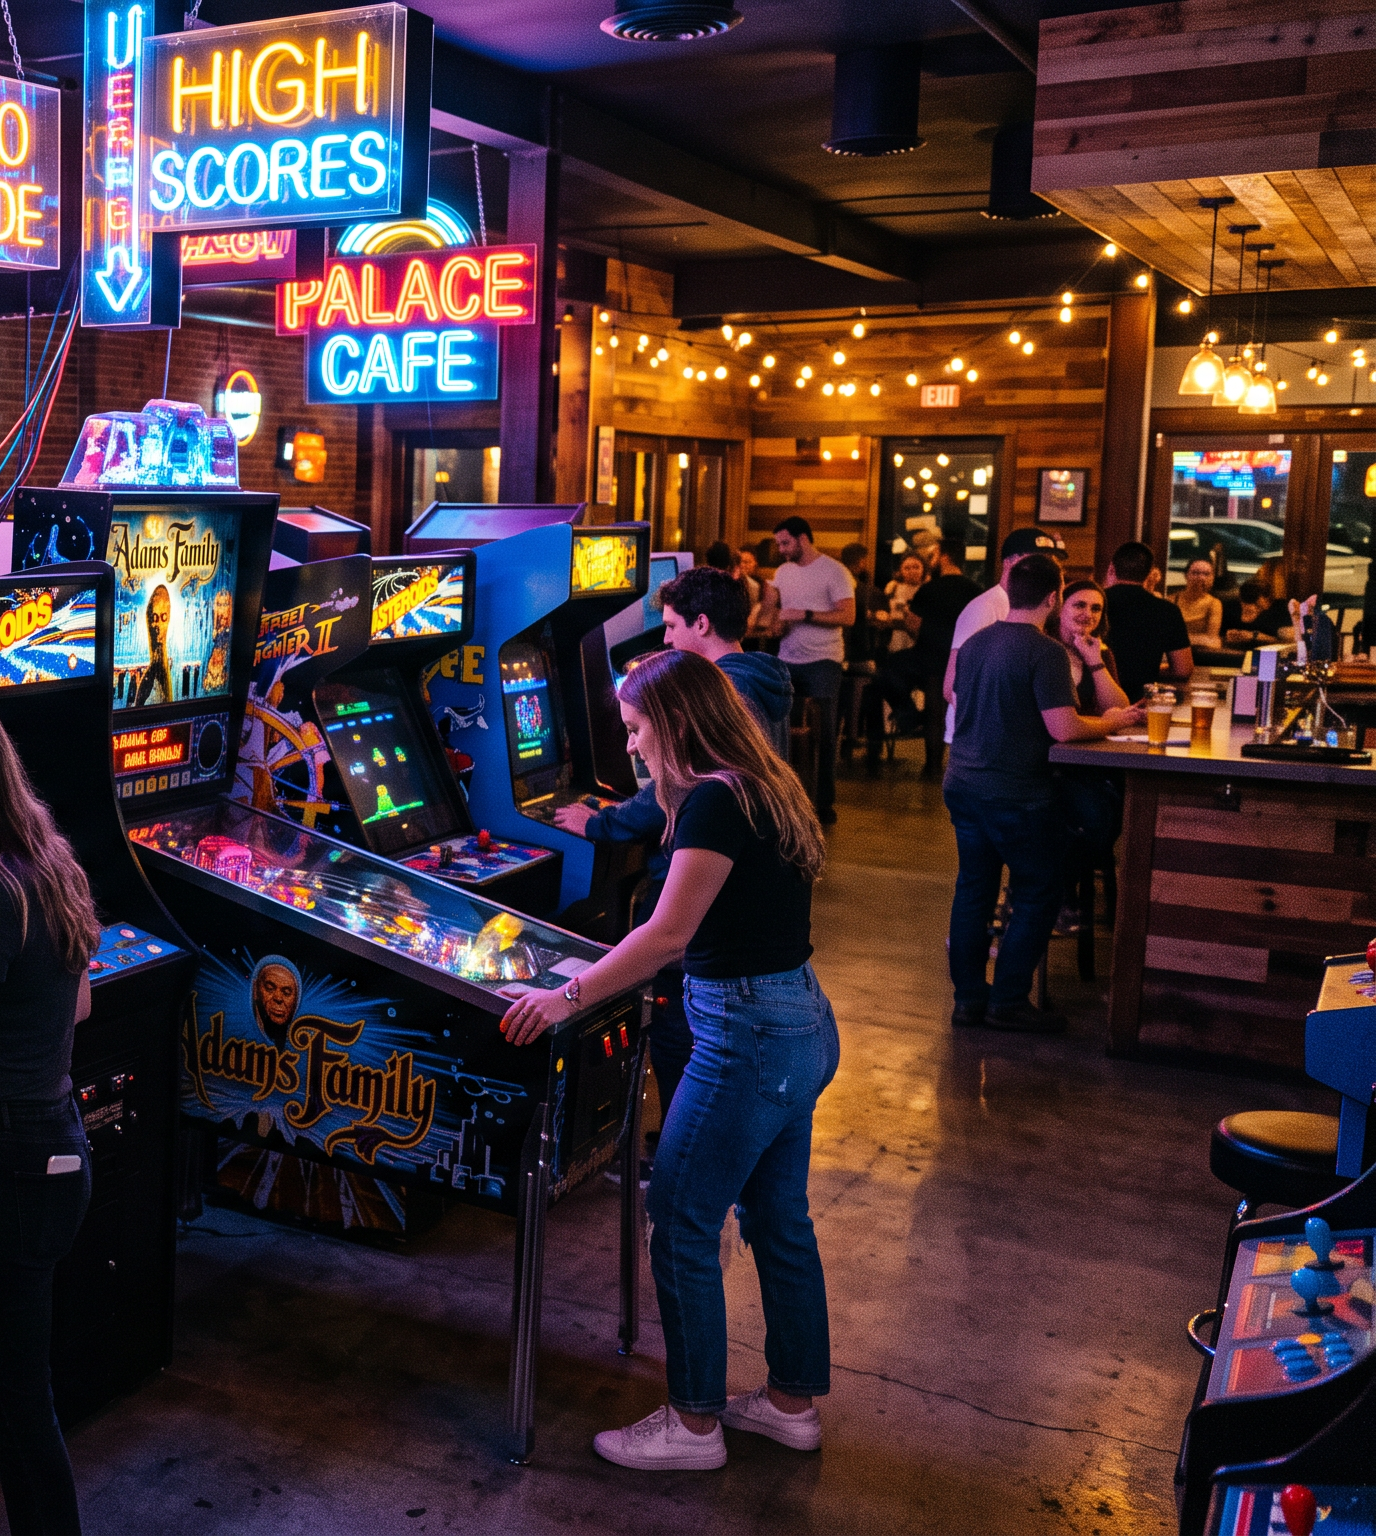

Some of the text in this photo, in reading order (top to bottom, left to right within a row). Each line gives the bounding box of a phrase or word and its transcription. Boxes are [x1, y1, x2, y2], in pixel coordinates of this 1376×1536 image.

[171, 31, 369, 134] HIGH
[149, 130, 387, 212] SCORES
[284, 253, 526, 329] PALACE
[320, 329, 477, 396] CAFE
[926, 386, 956, 406] EXIT
[111, 519, 219, 583] Adams Family
[284, 1014, 437, 1166] Family
